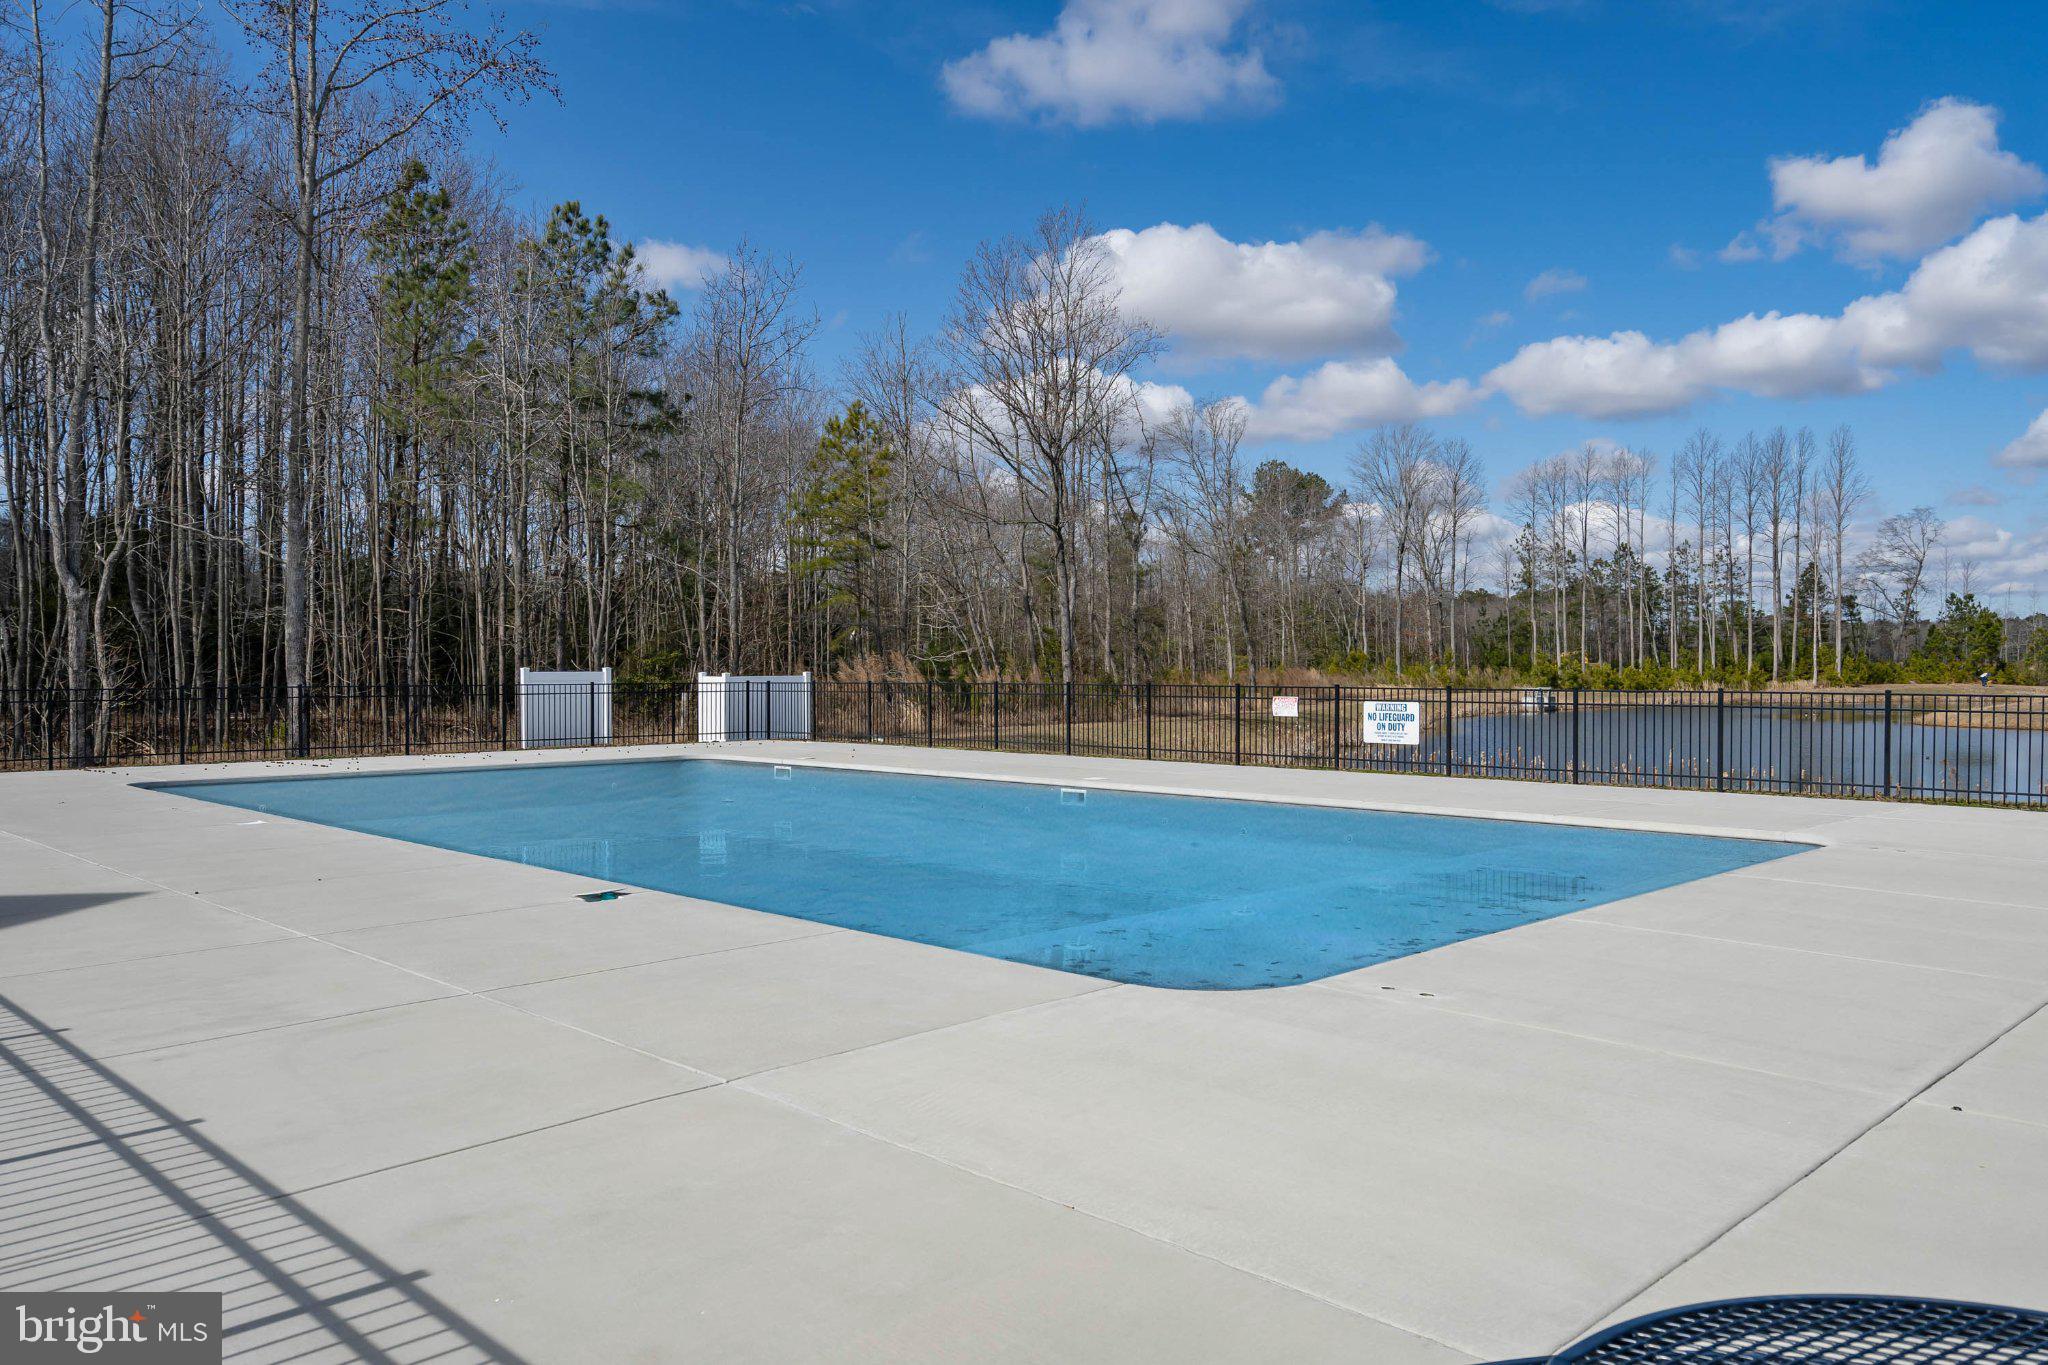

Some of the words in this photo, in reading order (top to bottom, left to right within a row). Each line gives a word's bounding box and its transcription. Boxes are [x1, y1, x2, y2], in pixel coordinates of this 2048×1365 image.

[1375, 703, 1407, 712] WARNING
[1367, 712, 1377, 721] NO
[1379, 713, 1415, 722] LIFEGUARD
[1376, 722, 1386, 731] ON
[1388, 722, 1406, 731] DUTY
